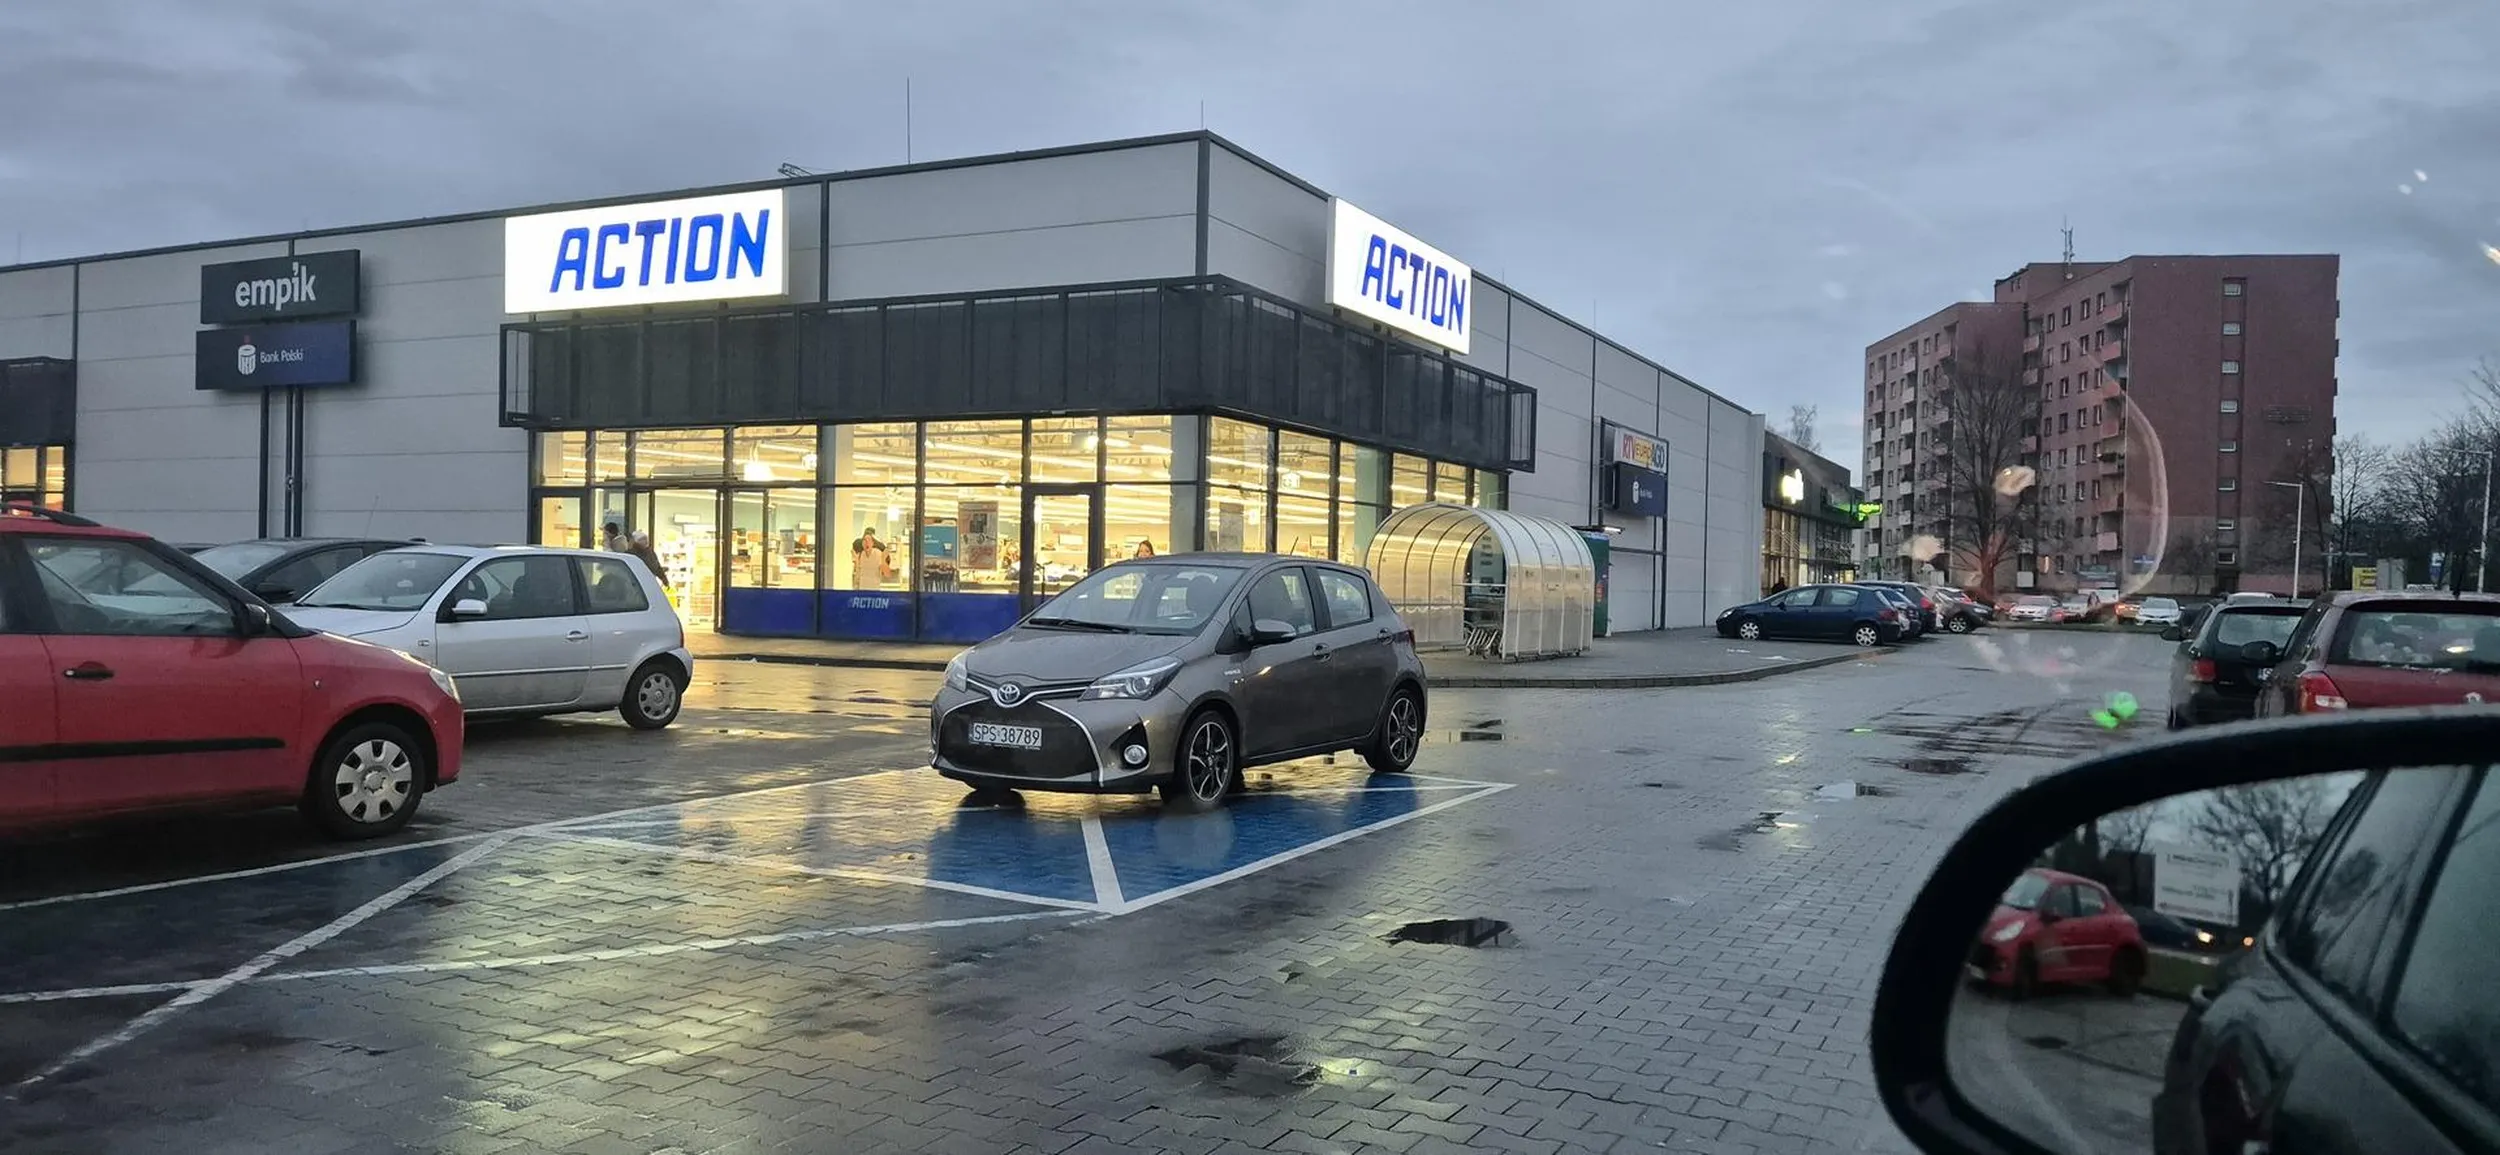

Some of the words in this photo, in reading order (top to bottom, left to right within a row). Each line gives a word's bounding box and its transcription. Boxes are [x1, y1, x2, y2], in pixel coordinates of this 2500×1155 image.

[549, 208, 770, 293] ACTION
[234, 261, 317, 311] empik
[1361, 233, 1467, 336] ACTION
[259, 350, 280, 363] Bank
[280, 348, 304, 362] Polski
[852, 596, 890, 609] ACTION
[974, 724, 998, 742] SPS
[1000, 726, 1041, 746] 38789
